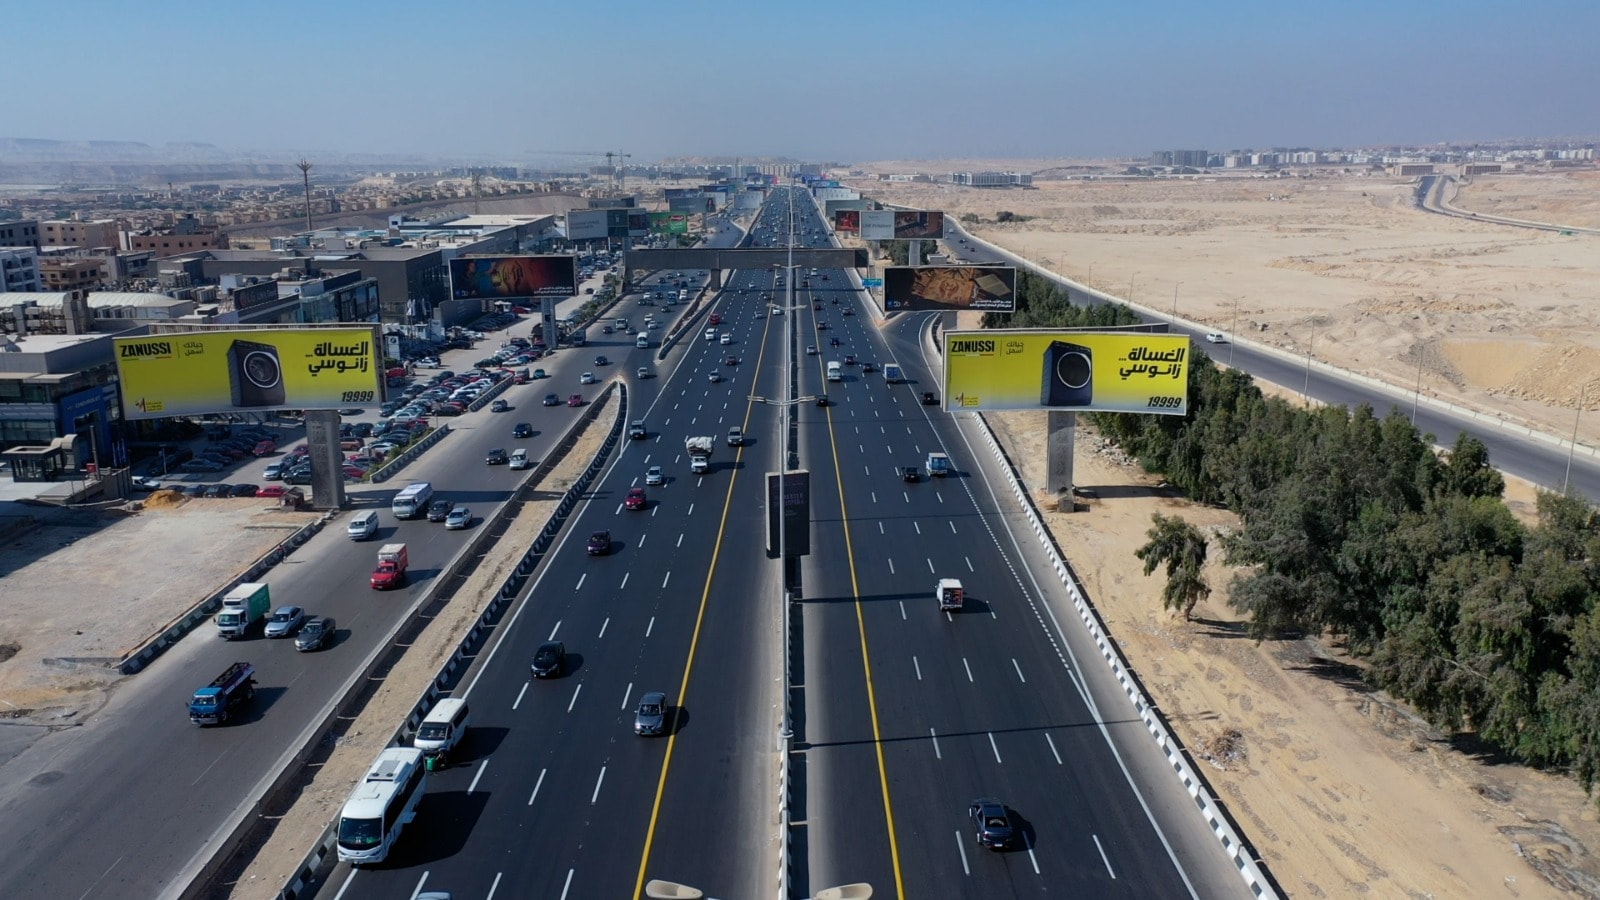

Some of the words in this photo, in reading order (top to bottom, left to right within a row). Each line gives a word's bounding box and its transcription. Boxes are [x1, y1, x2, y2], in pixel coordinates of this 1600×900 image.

[120, 342, 171, 358] ZANUSSI
[951, 340, 995, 352] ZANUSSI
[341, 390, 374, 402] 19999
[1147, 396, 1182, 408] 19999
